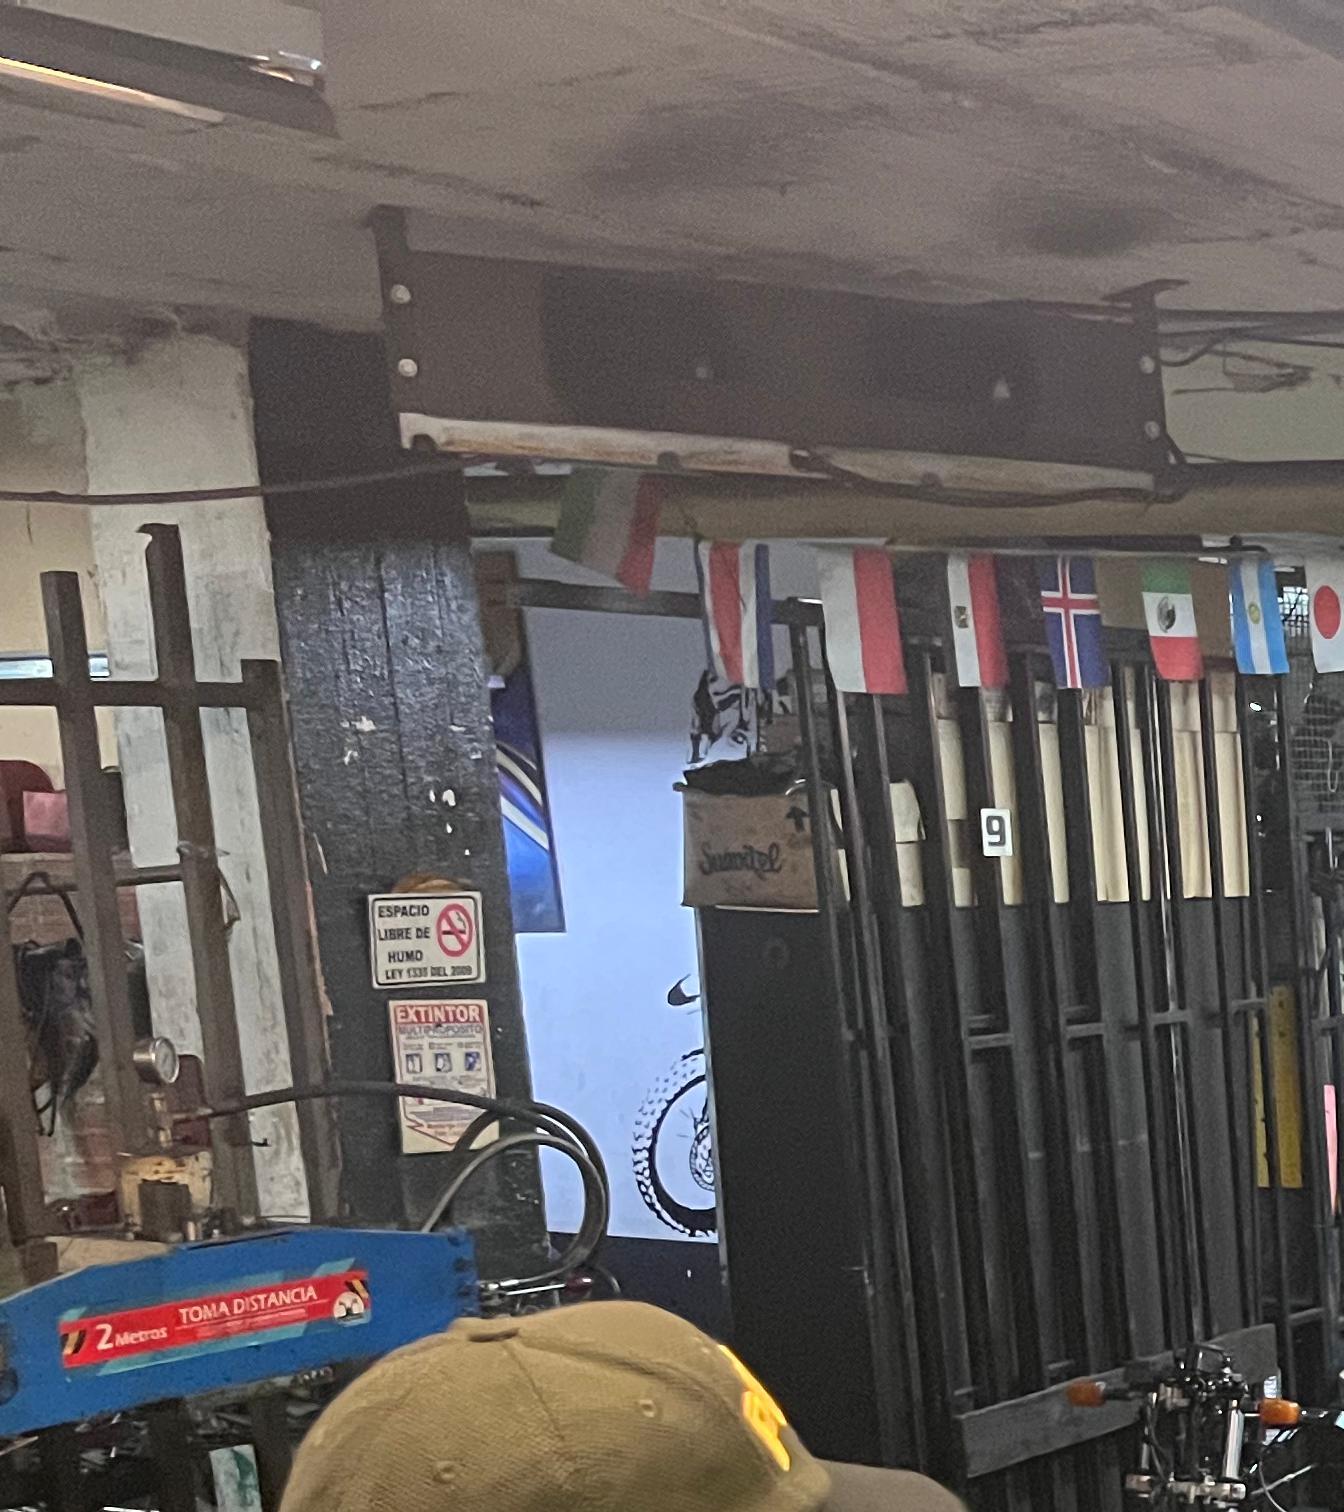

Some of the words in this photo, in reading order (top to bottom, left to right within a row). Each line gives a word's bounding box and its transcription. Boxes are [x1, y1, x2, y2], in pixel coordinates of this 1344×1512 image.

[986, 815, 1006, 847] 9
[378, 905, 430, 918] ESPACIO
[378, 927, 412, 941] LIBRE
[415, 927, 430, 939] DE
[388, 950, 424, 963] HUMO
[385, 969, 403, 980] LEY
[396, 1005, 481, 1023] EXTINTOR
[179, 1301, 231, 1324] TOMA
[233, 1285, 318, 1315] DISTANCIA
[96, 1323, 113, 1350] 2
[115, 1326, 168, 1348] Metros
